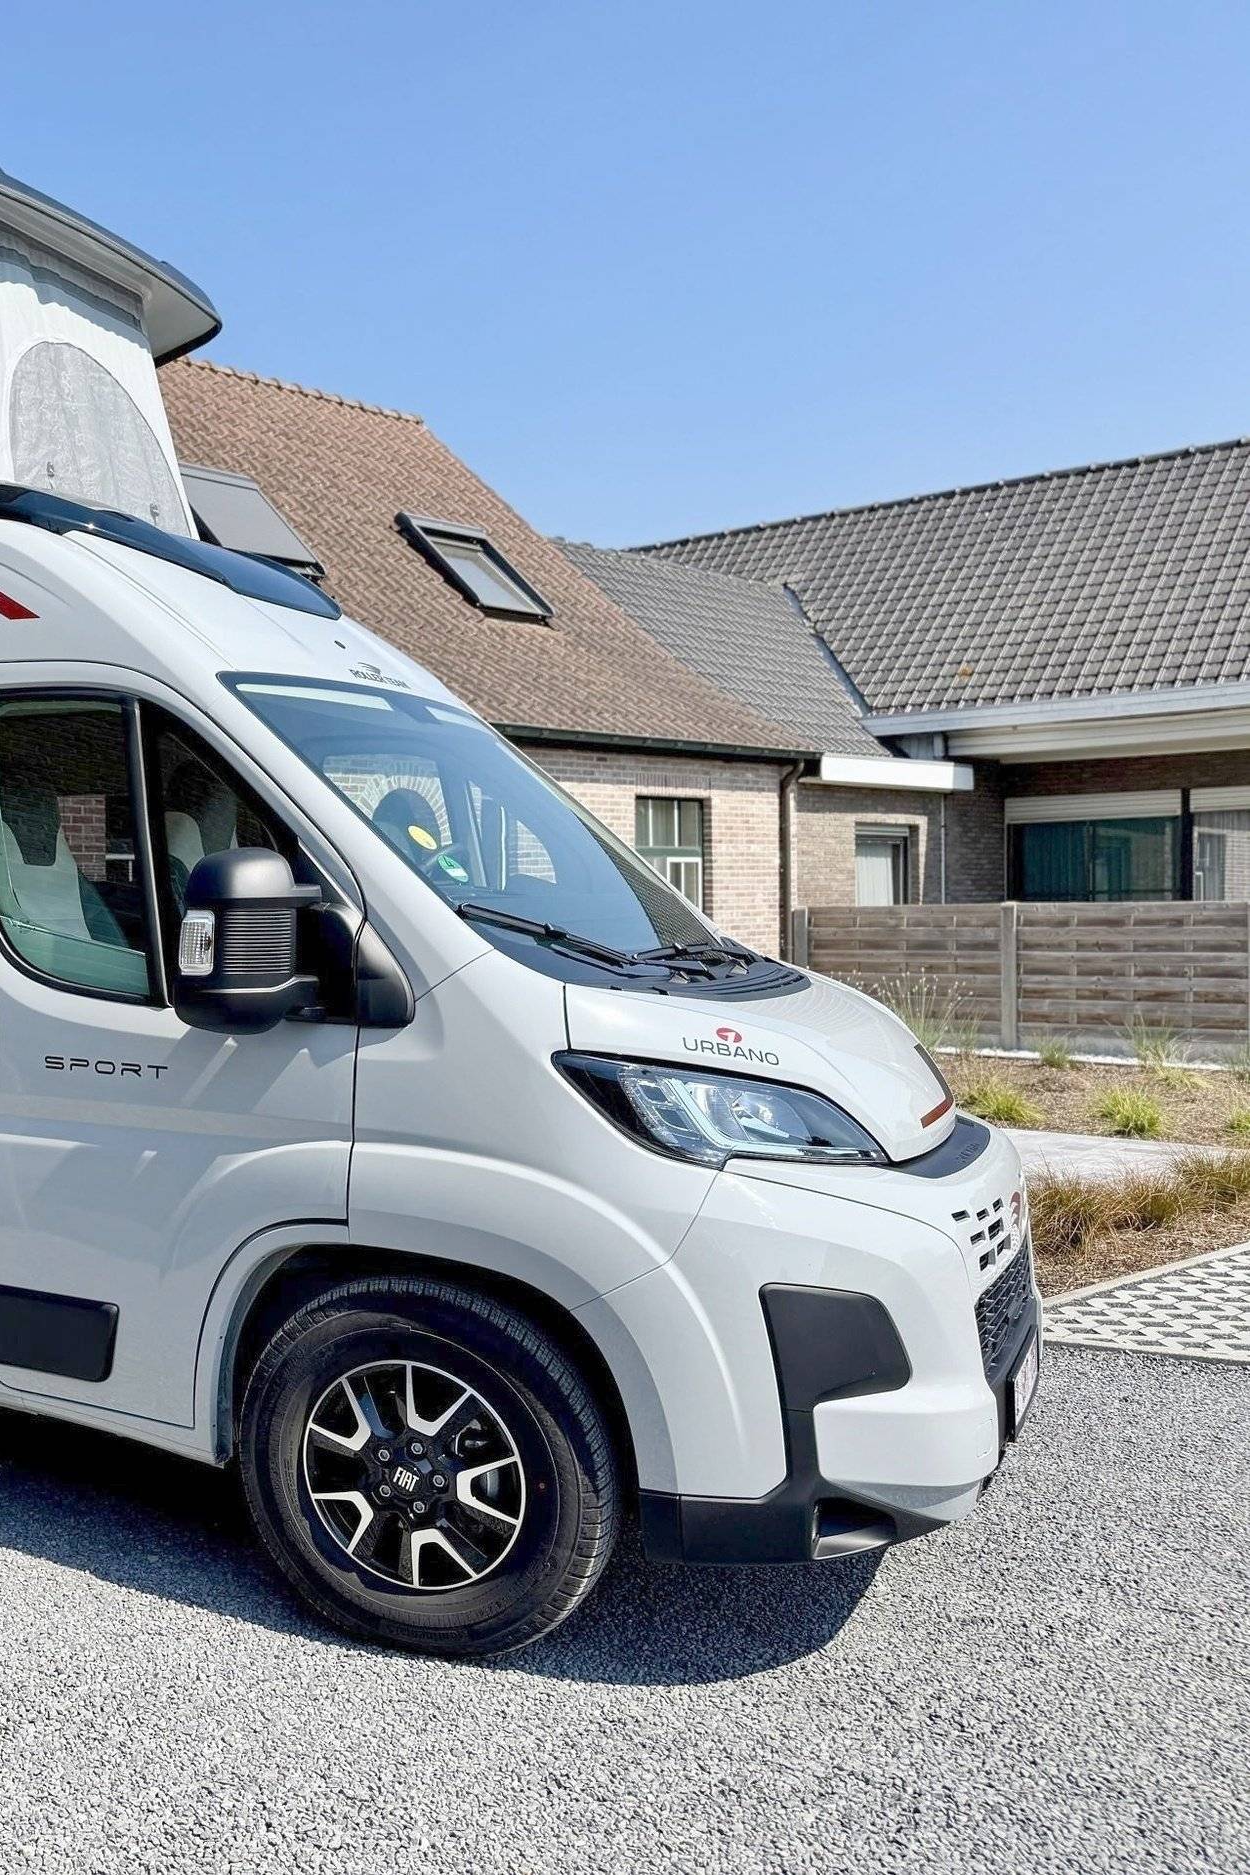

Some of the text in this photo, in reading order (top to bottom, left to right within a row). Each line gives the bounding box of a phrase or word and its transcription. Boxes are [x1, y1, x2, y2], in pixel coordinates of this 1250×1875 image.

[682, 1036, 780, 1066] URBANO
[44, 1055, 169, 1079] SPORT
[393, 1466, 420, 1492] FIAT
